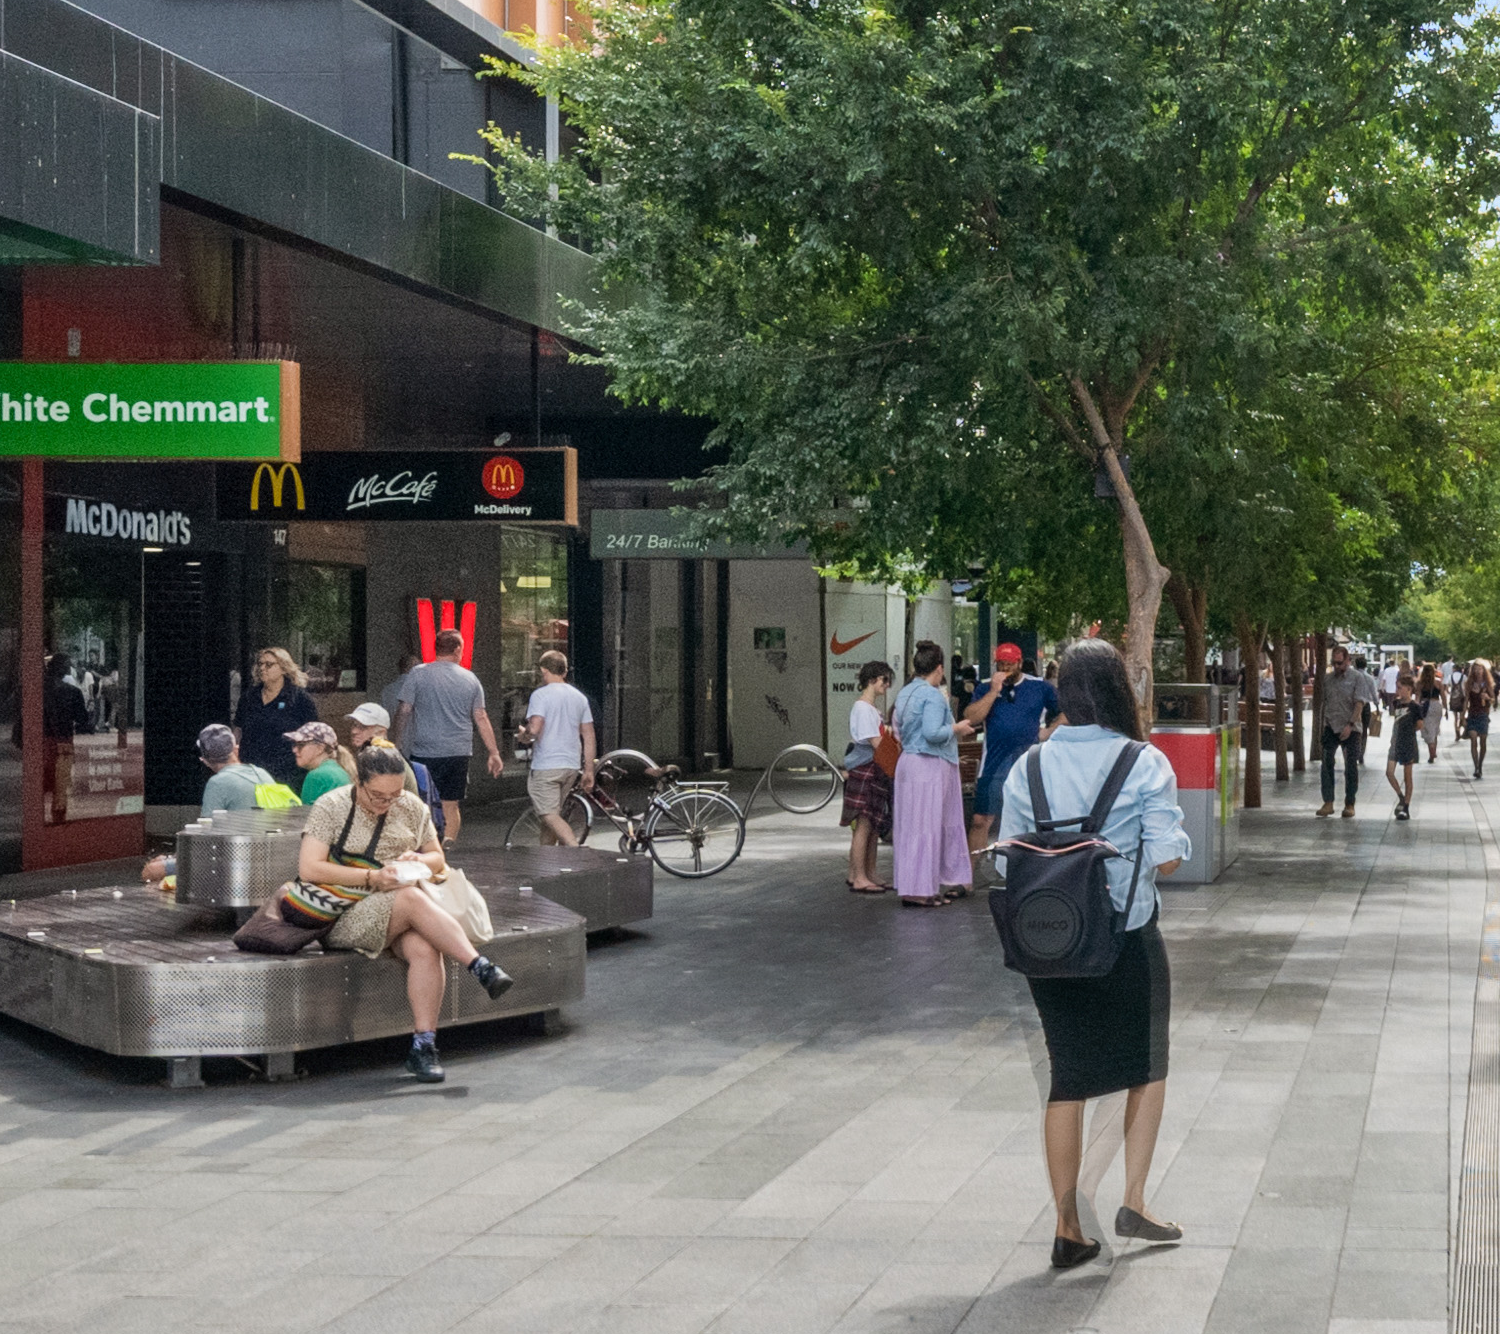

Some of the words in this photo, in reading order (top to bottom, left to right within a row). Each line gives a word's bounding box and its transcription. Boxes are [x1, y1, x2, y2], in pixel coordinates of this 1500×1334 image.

[82, 393, 270, 424] Chemmart
[347, 471, 438, 508] McCafé
[474, 504, 532, 516] McDelivery
[66, 499, 191, 545] McDonald's
[606, 534, 643, 549] 24/7
[832, 682, 856, 692] NOW
